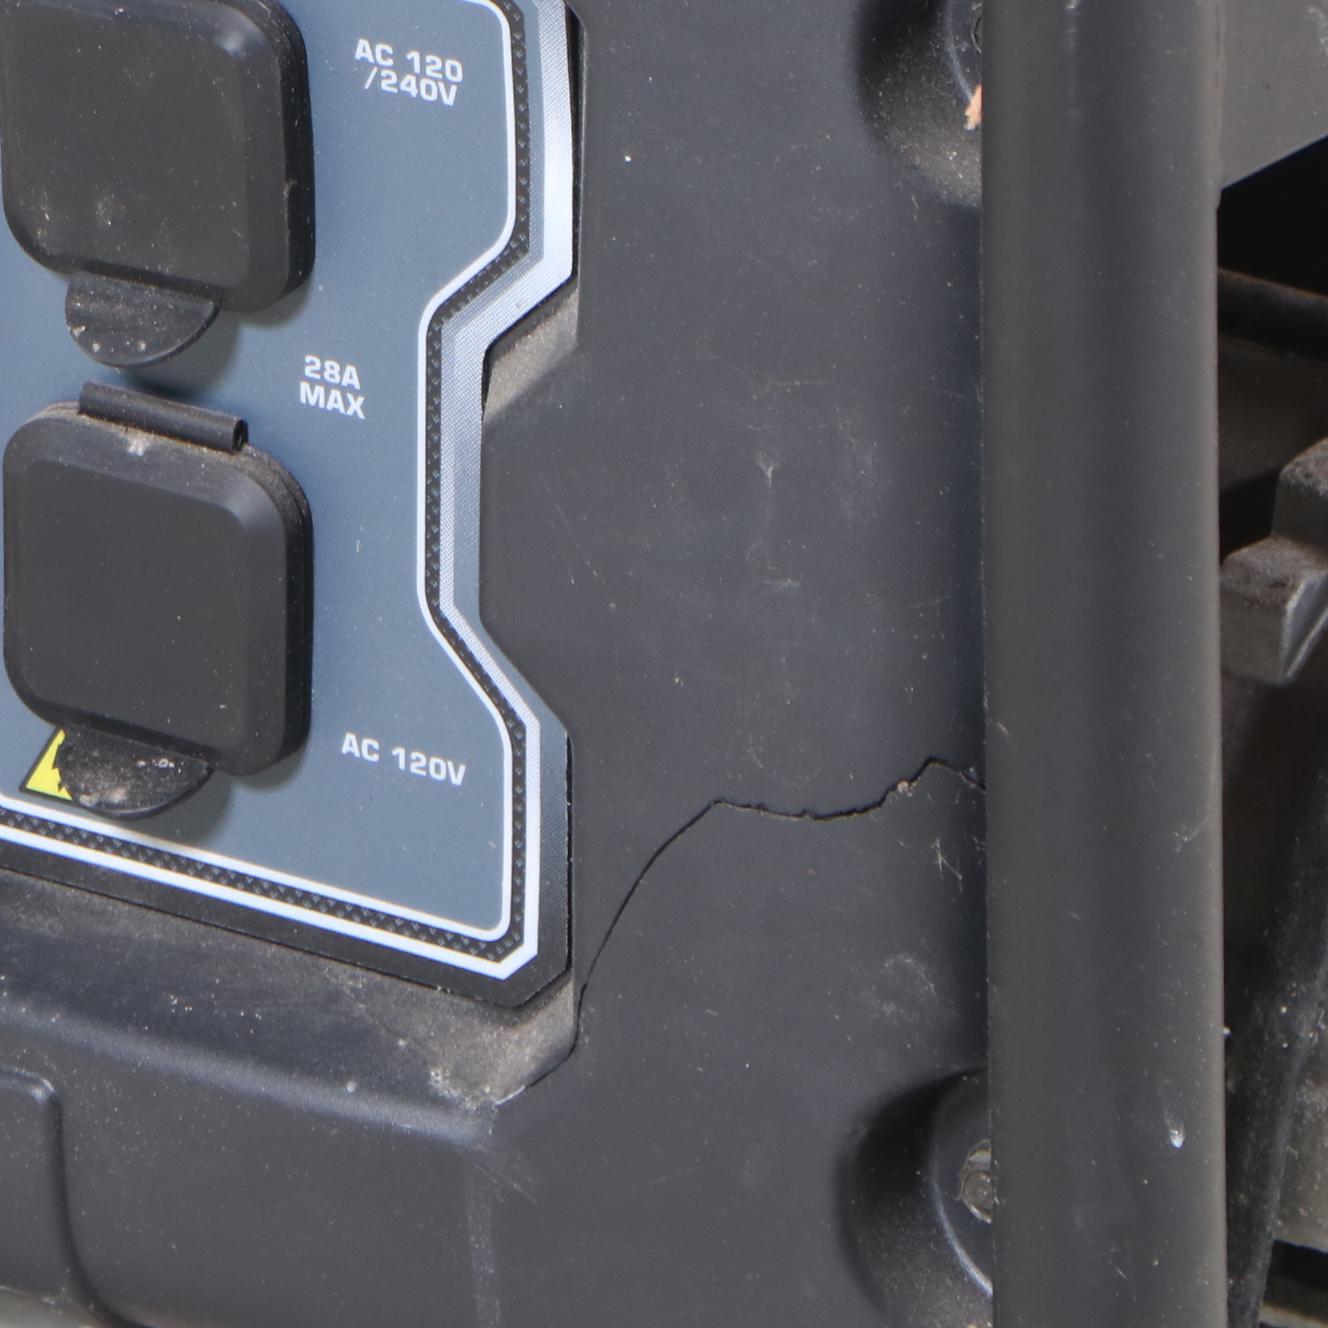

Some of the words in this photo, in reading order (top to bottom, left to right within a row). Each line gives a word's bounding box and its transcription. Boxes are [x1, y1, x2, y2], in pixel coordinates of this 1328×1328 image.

[355, 38, 393, 66] AC
[406, 51, 463, 84] 120
[364, 67, 458, 106] /240V
[305, 355, 361, 390] 28A
[300, 381, 366, 420] MAX
[342, 732, 380, 762] AC
[392, 747, 466, 786] 120V
